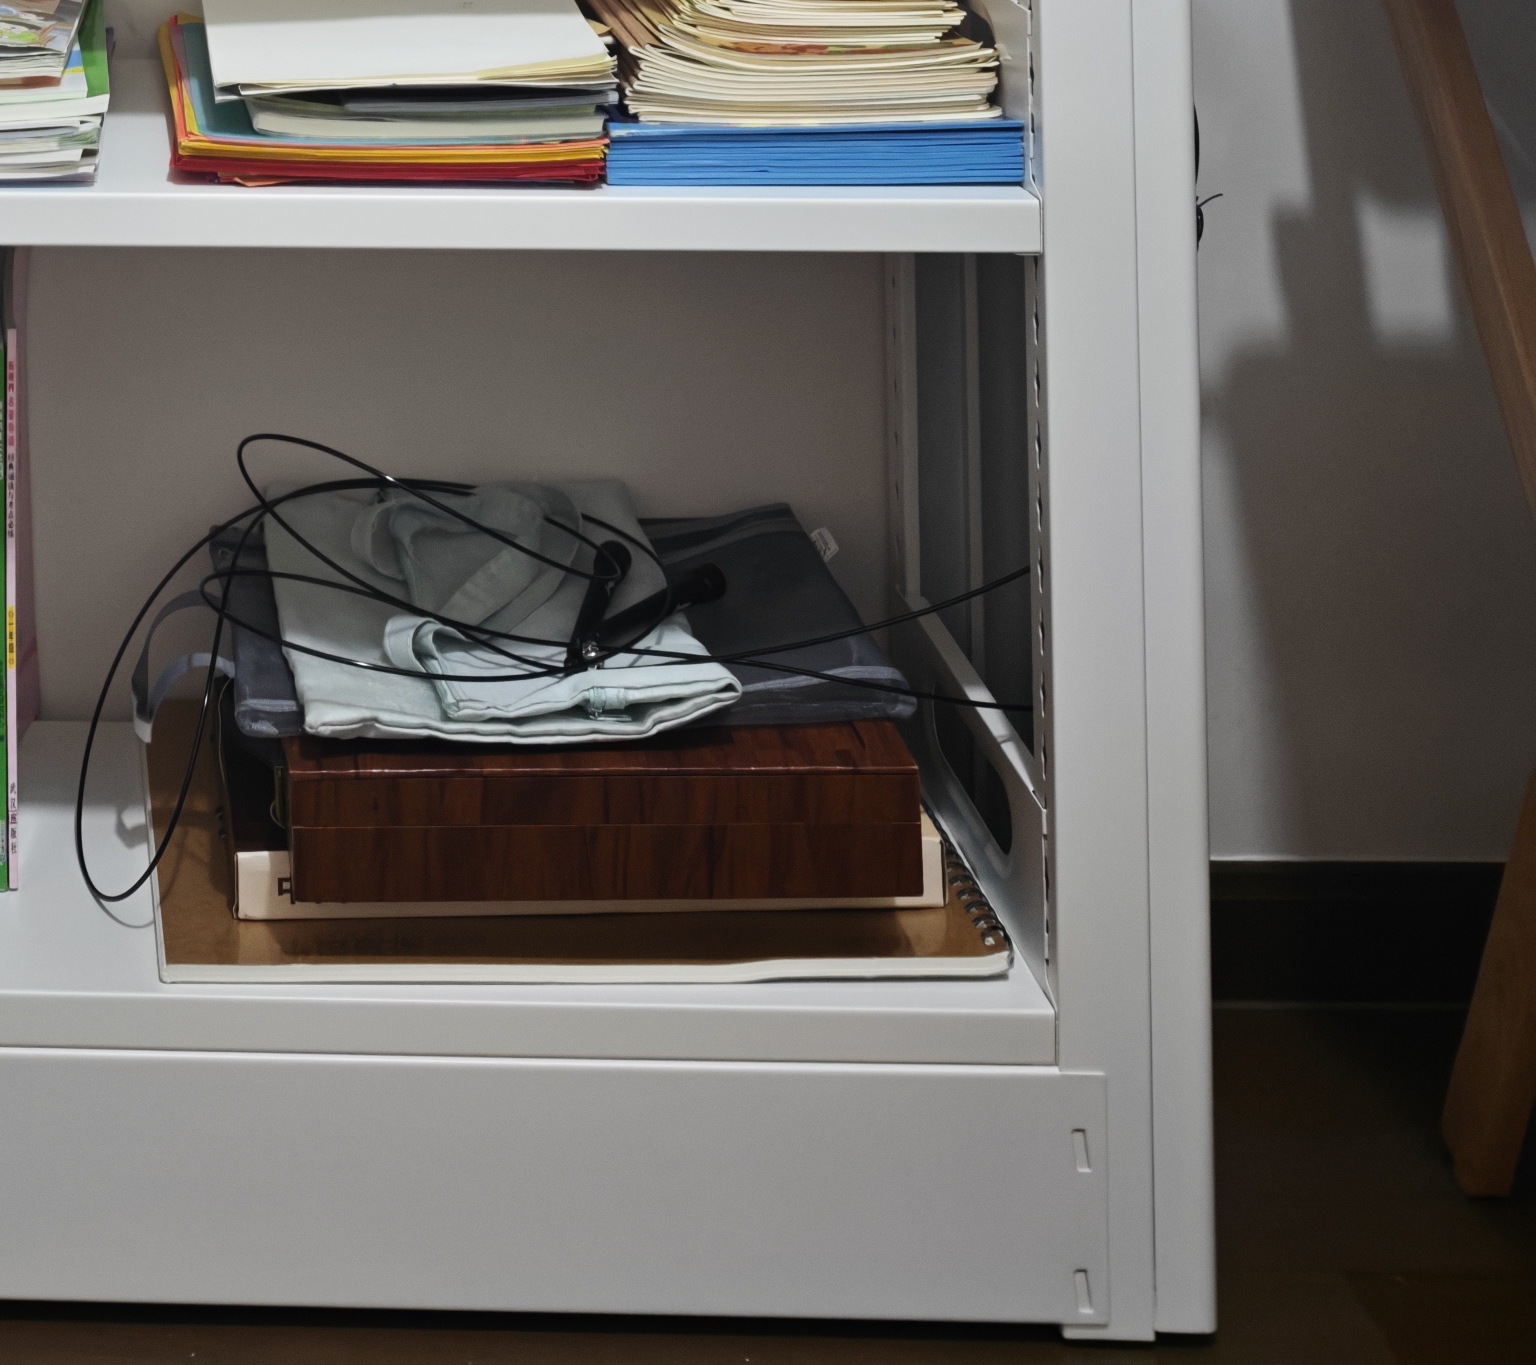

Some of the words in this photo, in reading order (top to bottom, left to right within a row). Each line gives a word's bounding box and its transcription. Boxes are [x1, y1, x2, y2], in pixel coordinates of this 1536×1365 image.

[9, 782, 18, 854] 武汉出版社
